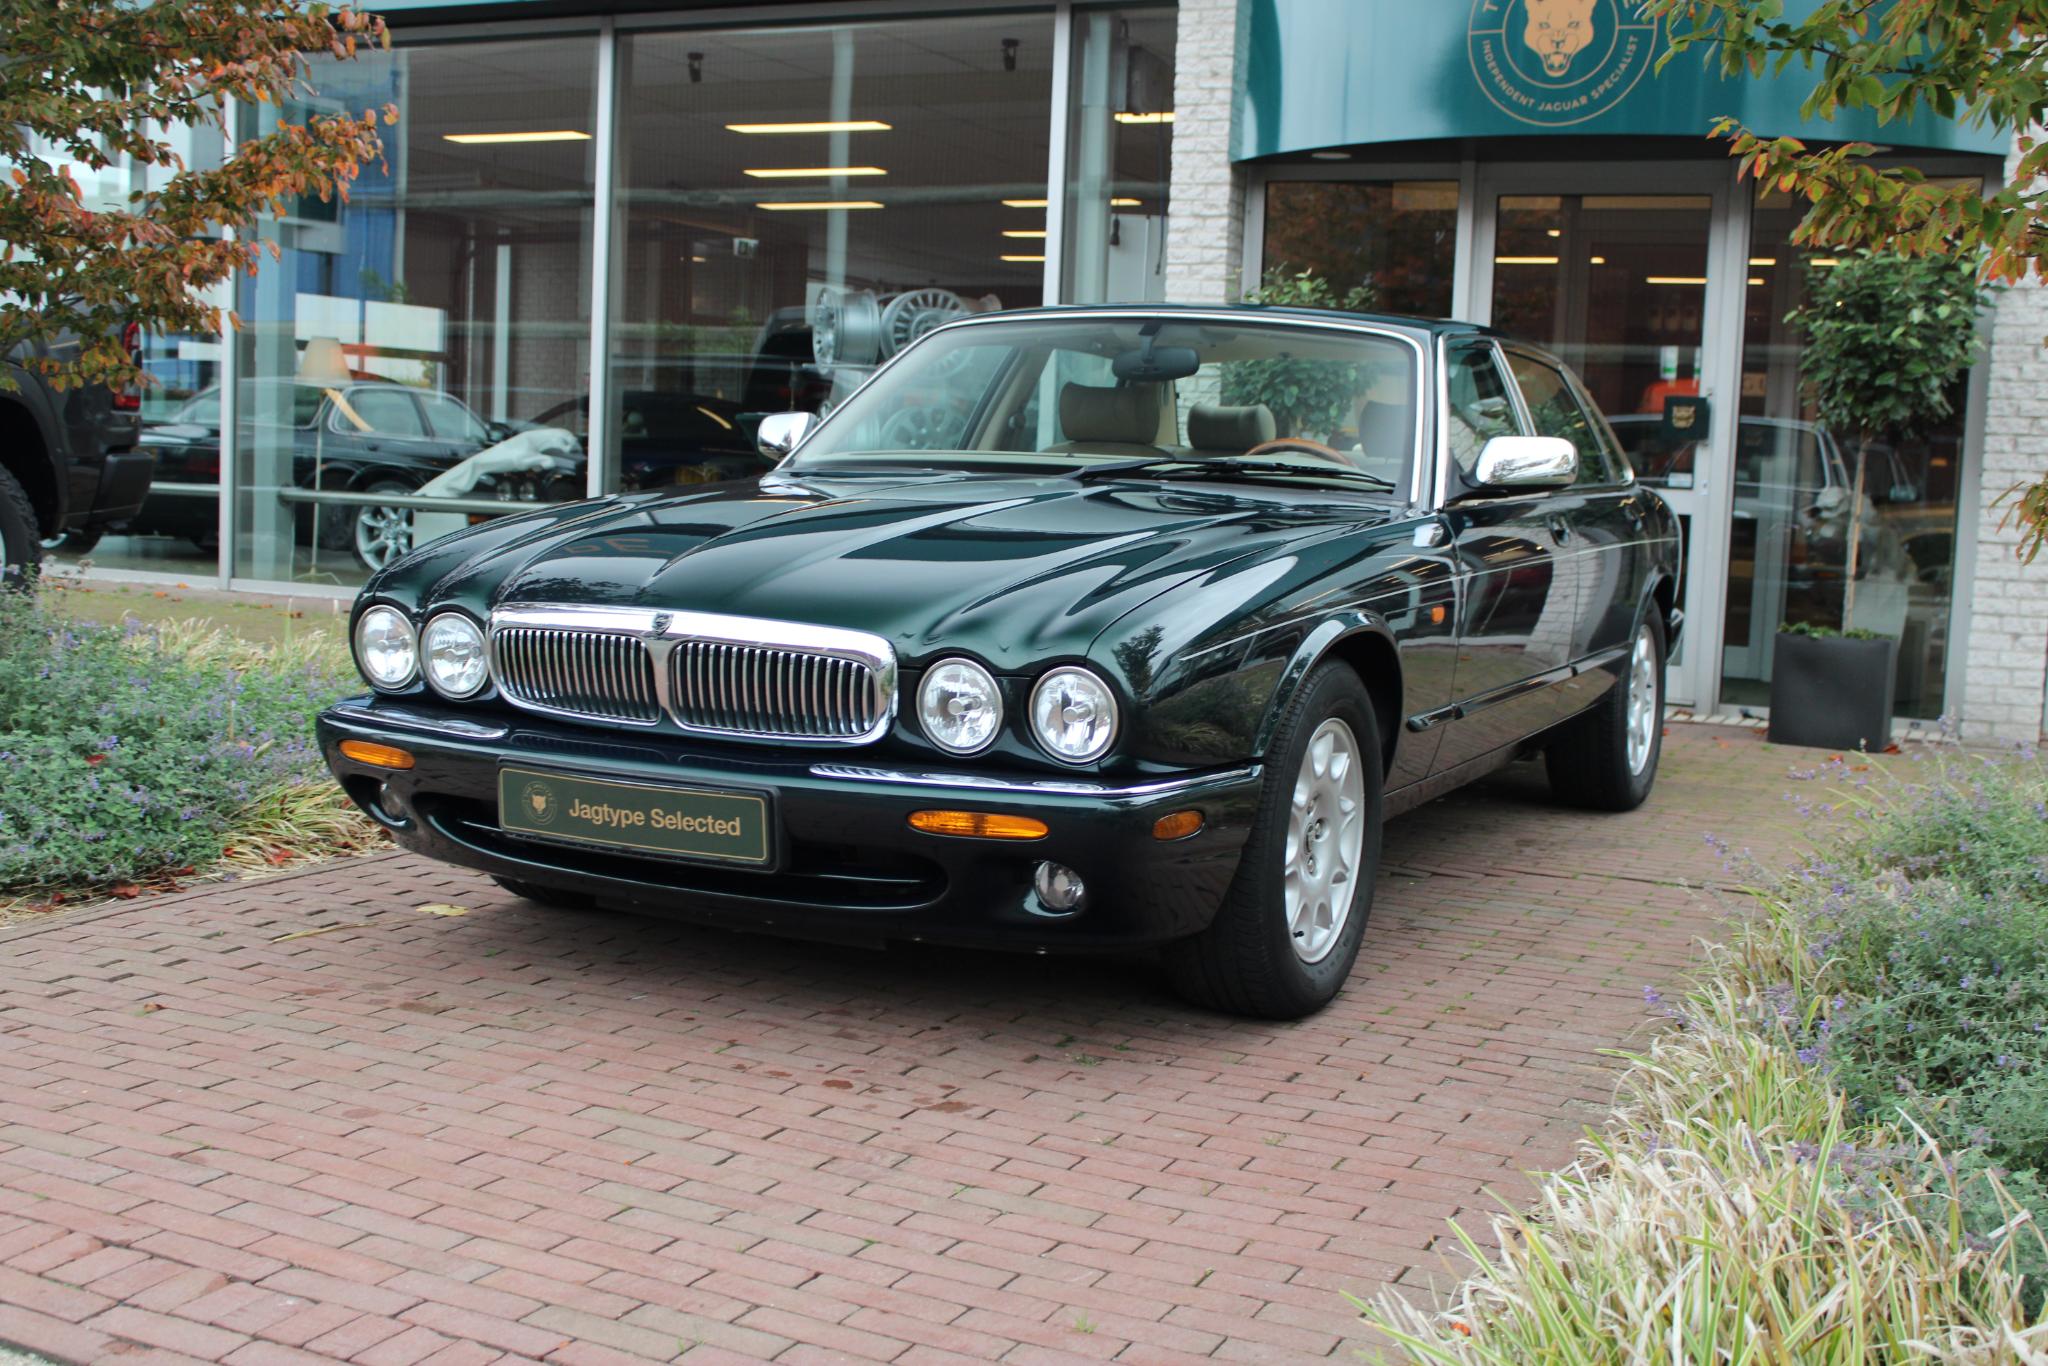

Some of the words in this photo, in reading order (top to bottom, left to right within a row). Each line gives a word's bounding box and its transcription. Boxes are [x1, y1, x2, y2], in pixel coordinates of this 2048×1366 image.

[1483, 40, 1535, 108] INDEPENDENT
[1537, 95, 1588, 112] JAGUAR
[1591, 36, 1638, 99] SPECIALIST
[569, 798, 646, 829] Jagtype
[650, 807, 742, 837] Selected
